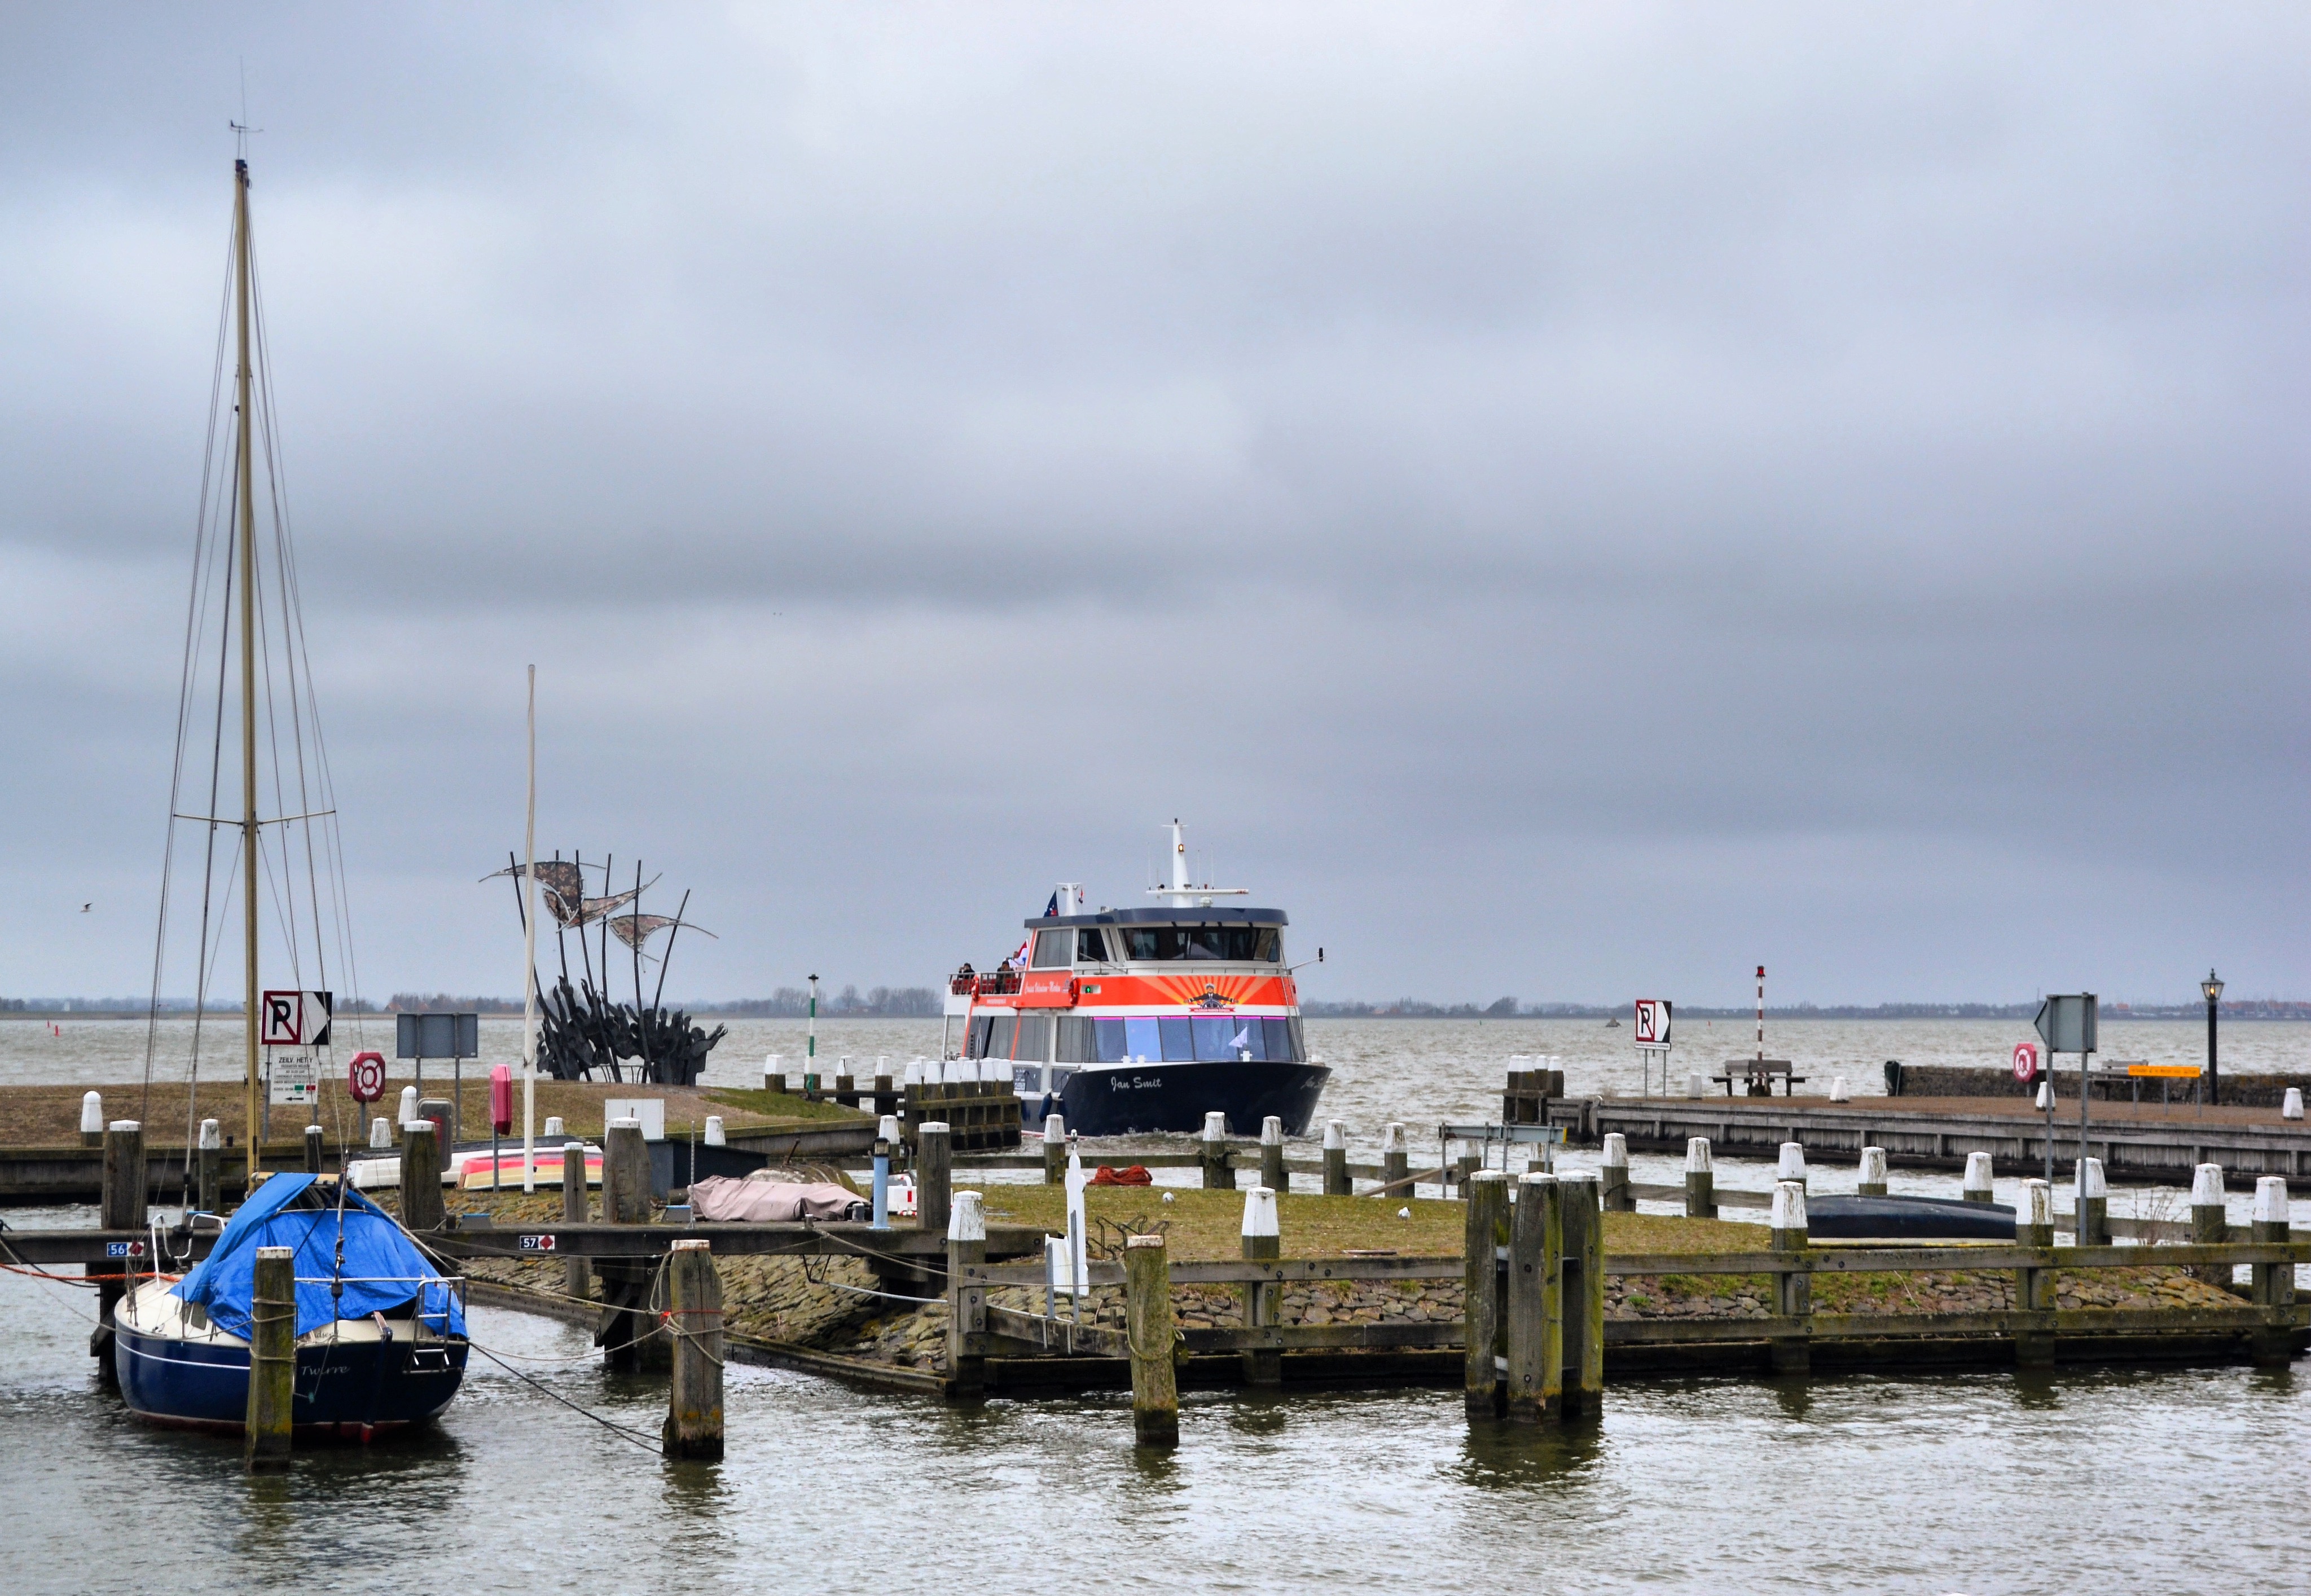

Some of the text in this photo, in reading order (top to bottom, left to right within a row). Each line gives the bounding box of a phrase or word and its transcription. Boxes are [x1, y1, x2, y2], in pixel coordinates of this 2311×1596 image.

[272, 1000, 291, 1035] P
[1641, 1008, 1650, 1034] P
[1110, 1076, 1162, 1092] Jan Smit
[111, 1245, 125, 1255] 56
[524, 1238, 536, 1247] 57
